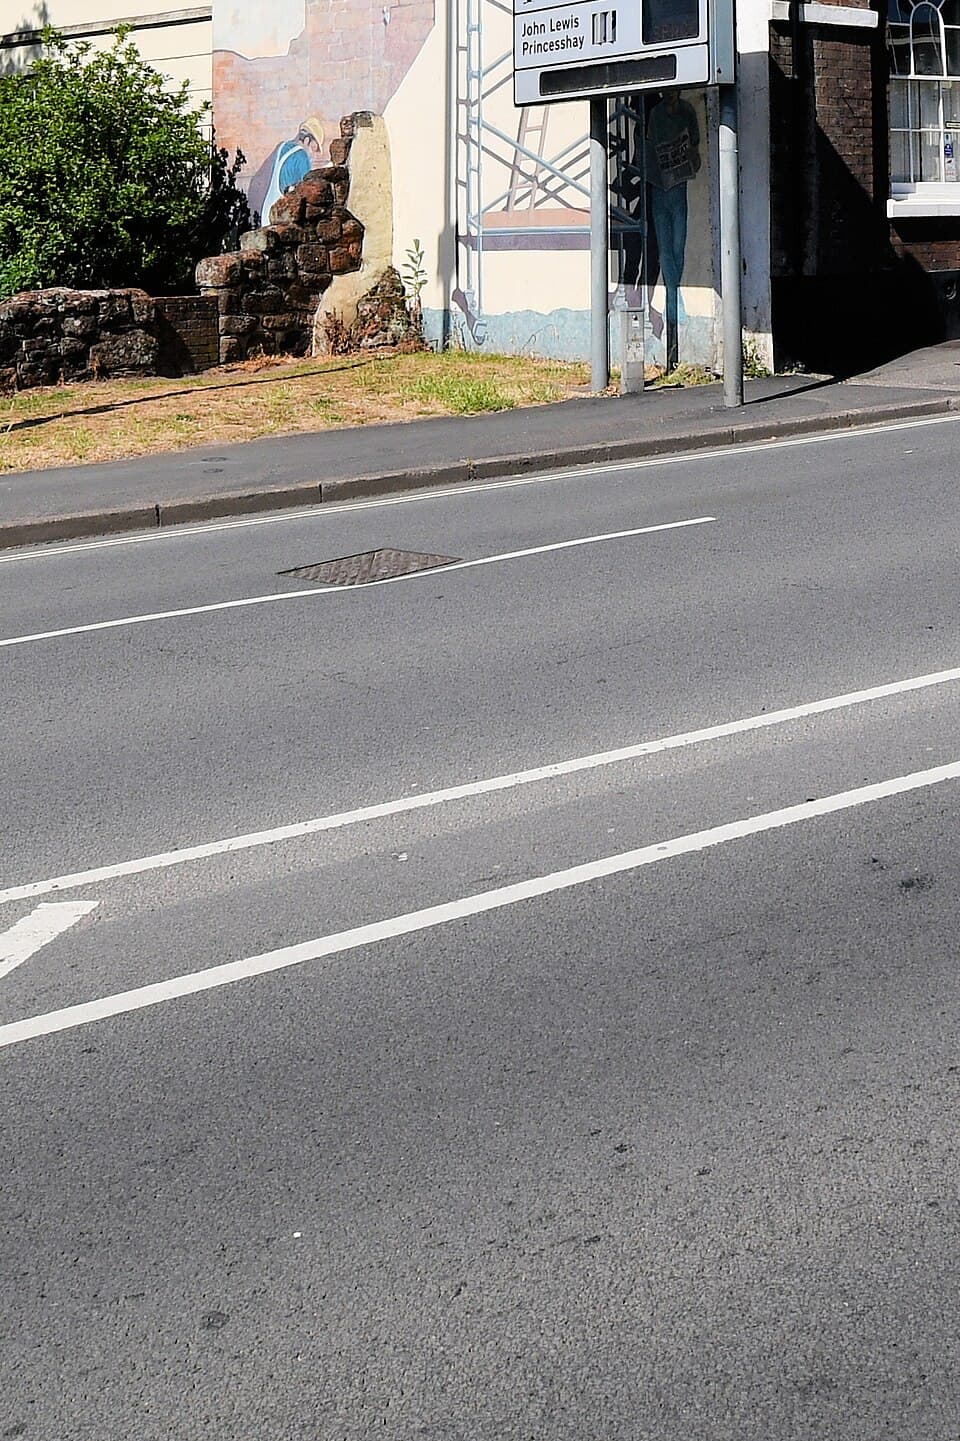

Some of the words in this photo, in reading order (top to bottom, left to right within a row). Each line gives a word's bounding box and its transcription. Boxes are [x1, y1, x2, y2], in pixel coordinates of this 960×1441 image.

[522, 20, 546, 37] John
[550, 15, 579, 32] Lewis
[522, 34, 585, 56] Princesshay
